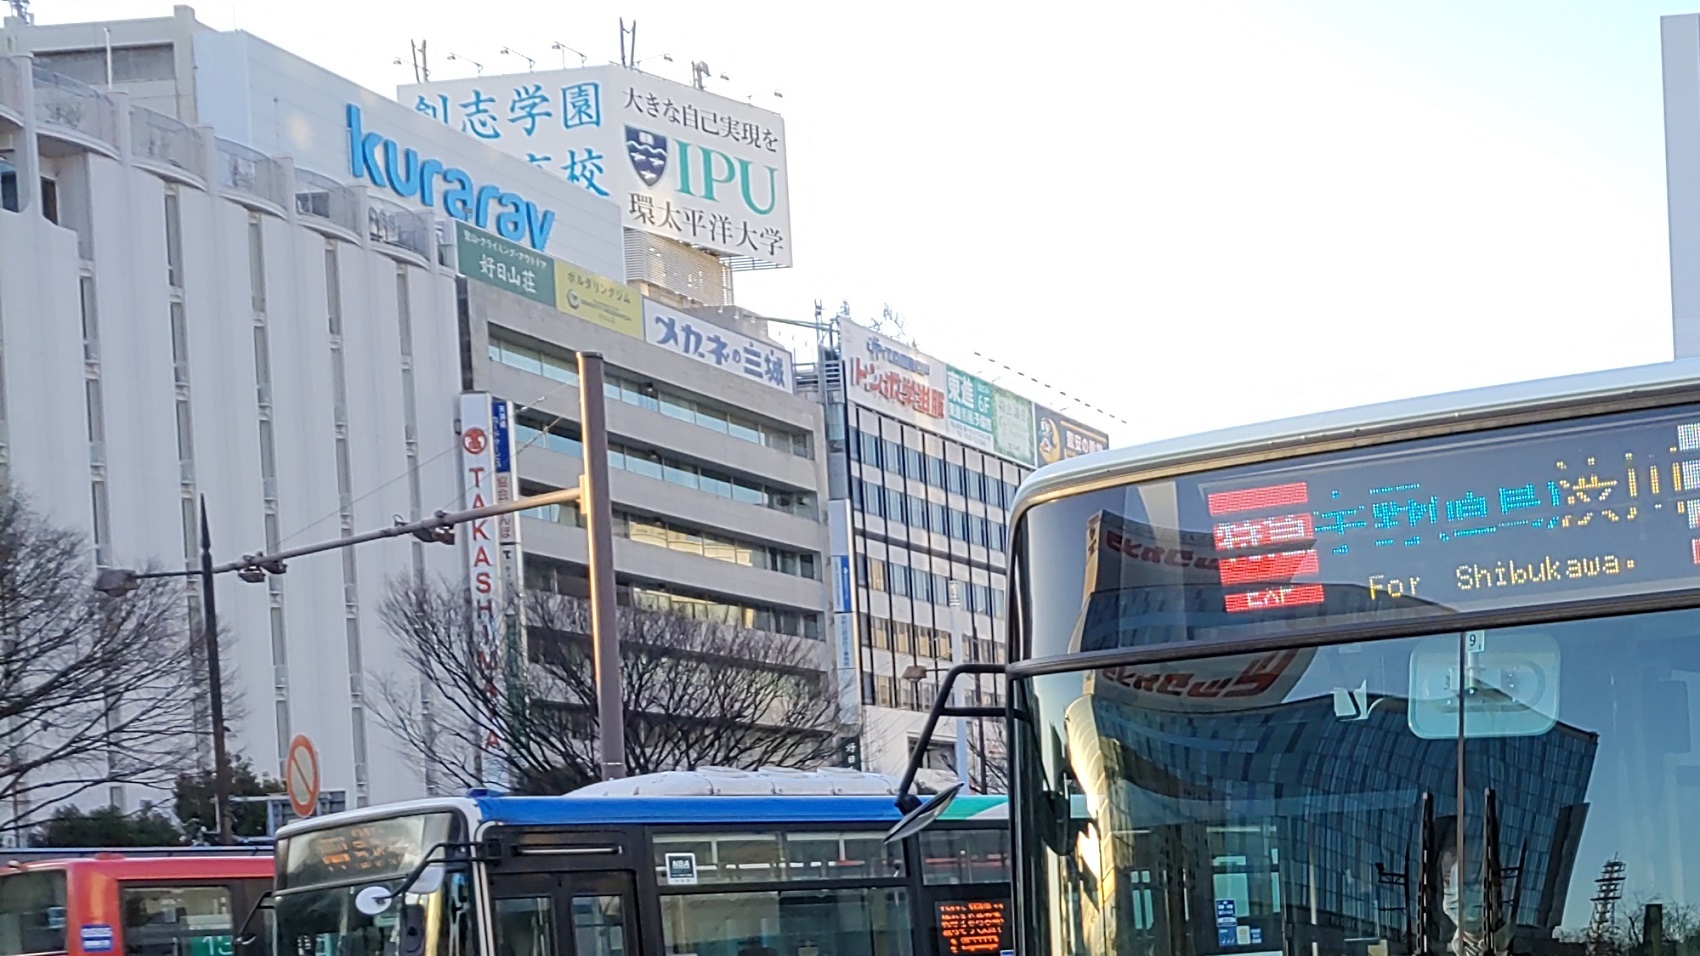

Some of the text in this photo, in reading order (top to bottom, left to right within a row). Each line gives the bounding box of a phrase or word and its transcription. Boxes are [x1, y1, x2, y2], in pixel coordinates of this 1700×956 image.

[622, 87, 778, 153] 大きな自己実現を
[672, 138, 778, 216] IPU
[628, 193, 784, 256] 環太平洋大学
[1369, 574, 1421, 600] For
